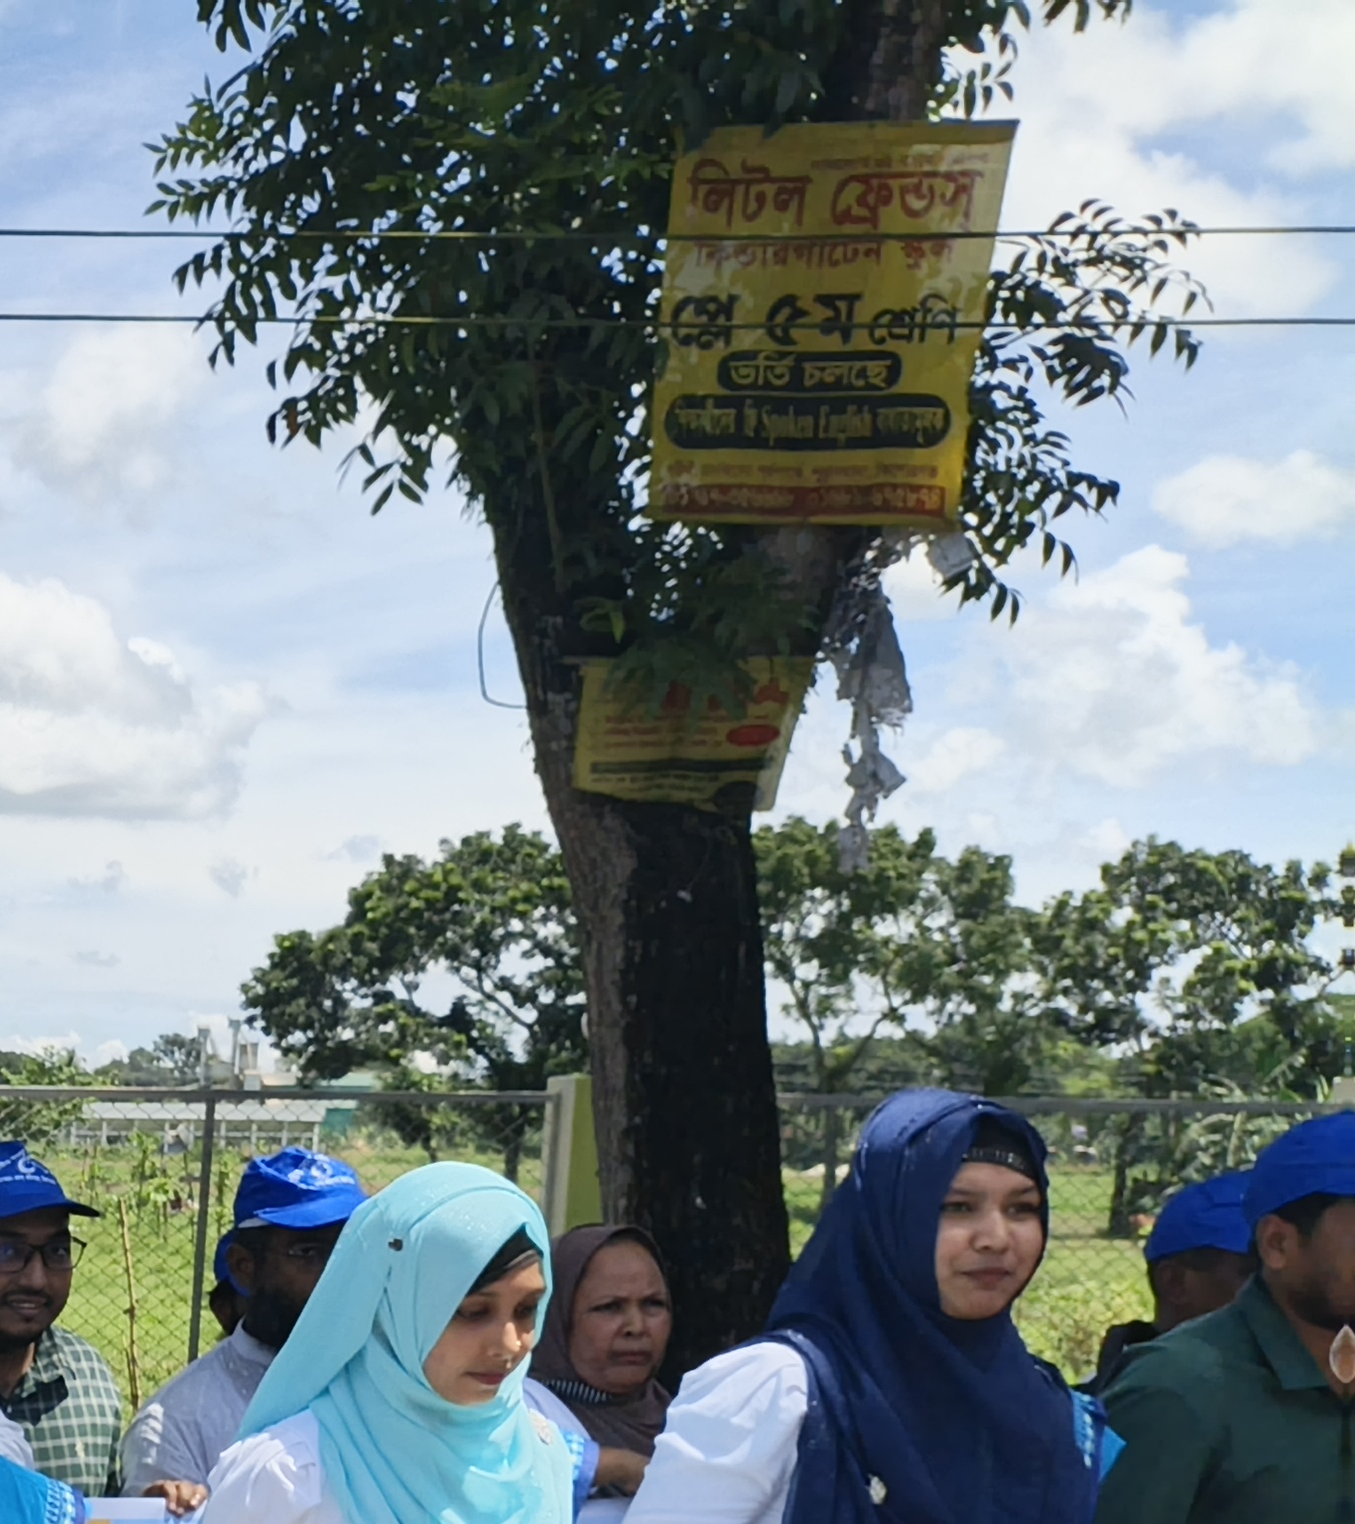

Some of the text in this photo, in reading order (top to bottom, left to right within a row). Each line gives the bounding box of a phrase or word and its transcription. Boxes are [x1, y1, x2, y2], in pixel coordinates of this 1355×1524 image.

[687, 158, 813, 228] লিটল
[729, 352, 893, 388] ভর্তি চলছে
